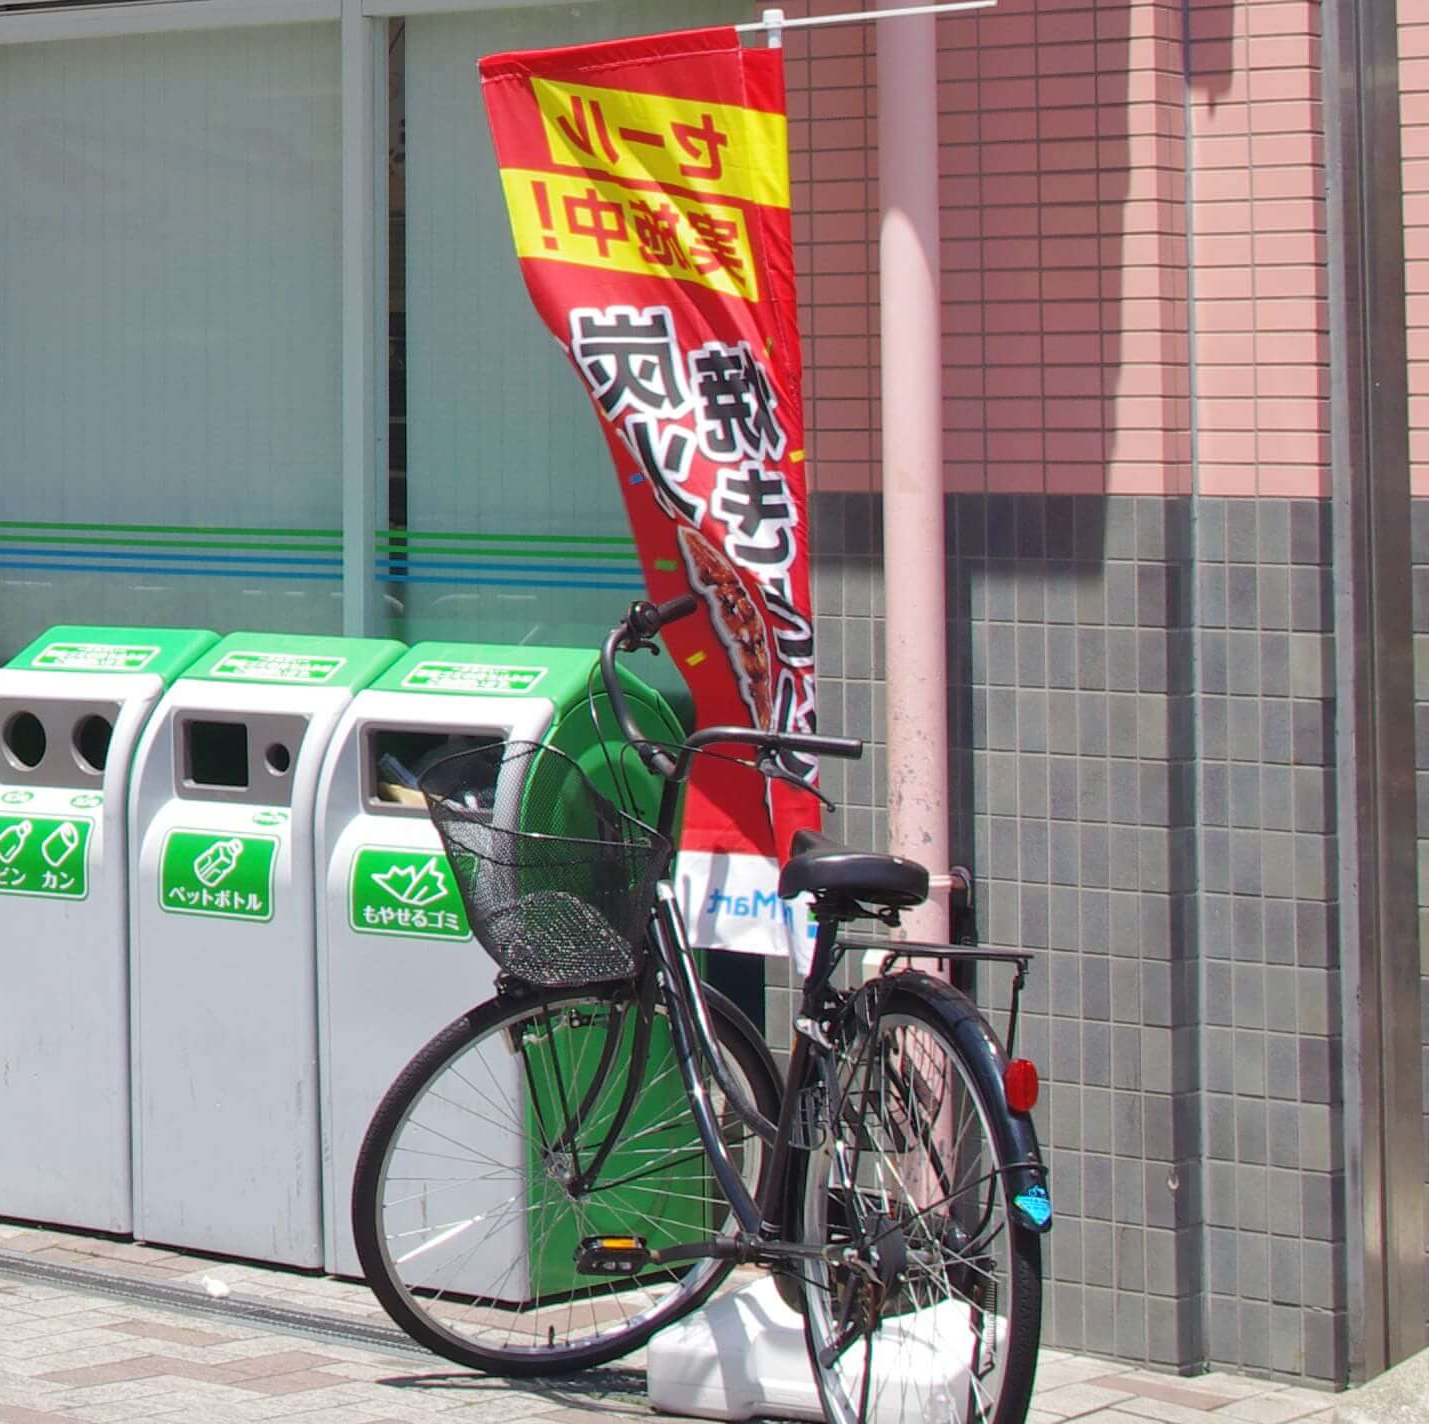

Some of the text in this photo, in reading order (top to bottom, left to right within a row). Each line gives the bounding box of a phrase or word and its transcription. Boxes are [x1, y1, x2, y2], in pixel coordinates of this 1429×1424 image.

[42, 871, 75, 889] カン
[169, 886, 263, 911] ペットボトル
[363, 905, 460, 931] もやせるゴミ
